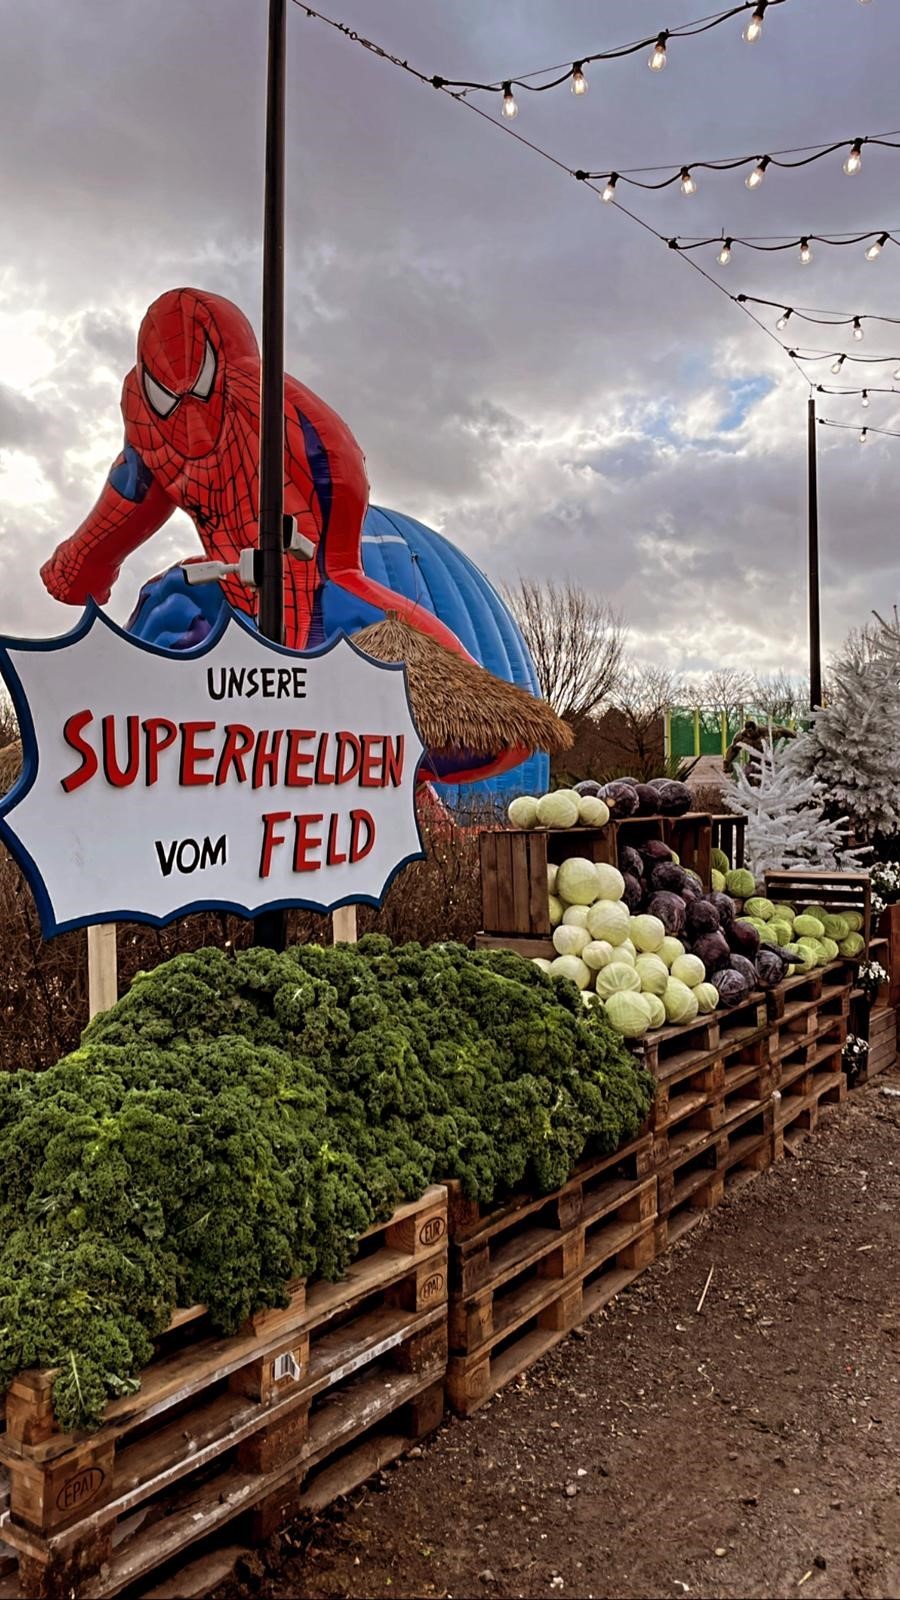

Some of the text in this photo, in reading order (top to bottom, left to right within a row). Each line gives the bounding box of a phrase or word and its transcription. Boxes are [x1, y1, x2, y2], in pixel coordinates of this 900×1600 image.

[207, 667, 308, 700] UNSERE
[60, 709, 405, 793] SUPERHELDEN
[155, 808, 376, 879] VOM FELD
[424, 1219, 441, 1243] EUR
